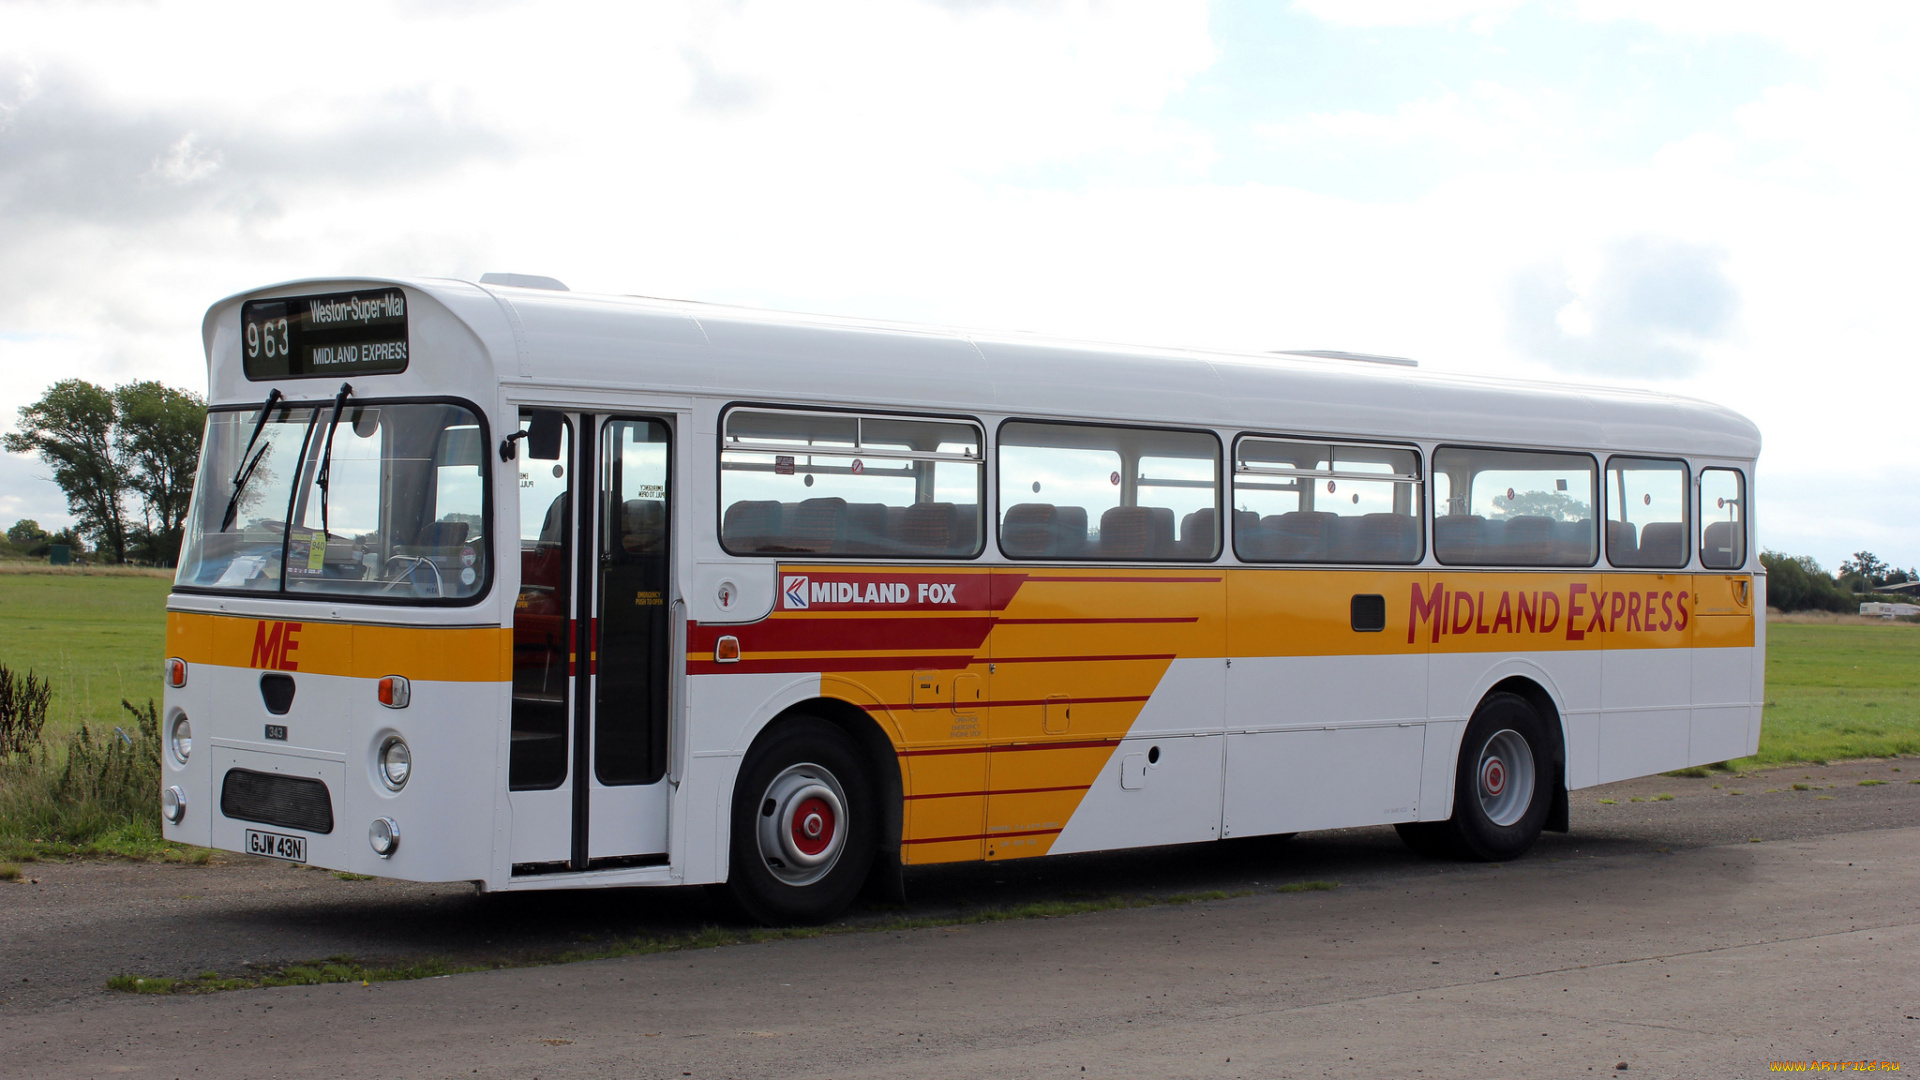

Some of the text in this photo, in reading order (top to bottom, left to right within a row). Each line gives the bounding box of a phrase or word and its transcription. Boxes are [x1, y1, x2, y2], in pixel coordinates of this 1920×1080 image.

[248, 318, 288, 358] 963
[313, 346, 358, 365] MIDLAND
[811, 582, 957, 604] MIDLAND FOX
[1407, 582, 1689, 644] MIDLAND EXPRESS
[250, 620, 303, 671] ME
[251, 833, 301, 859] GJW 43N
